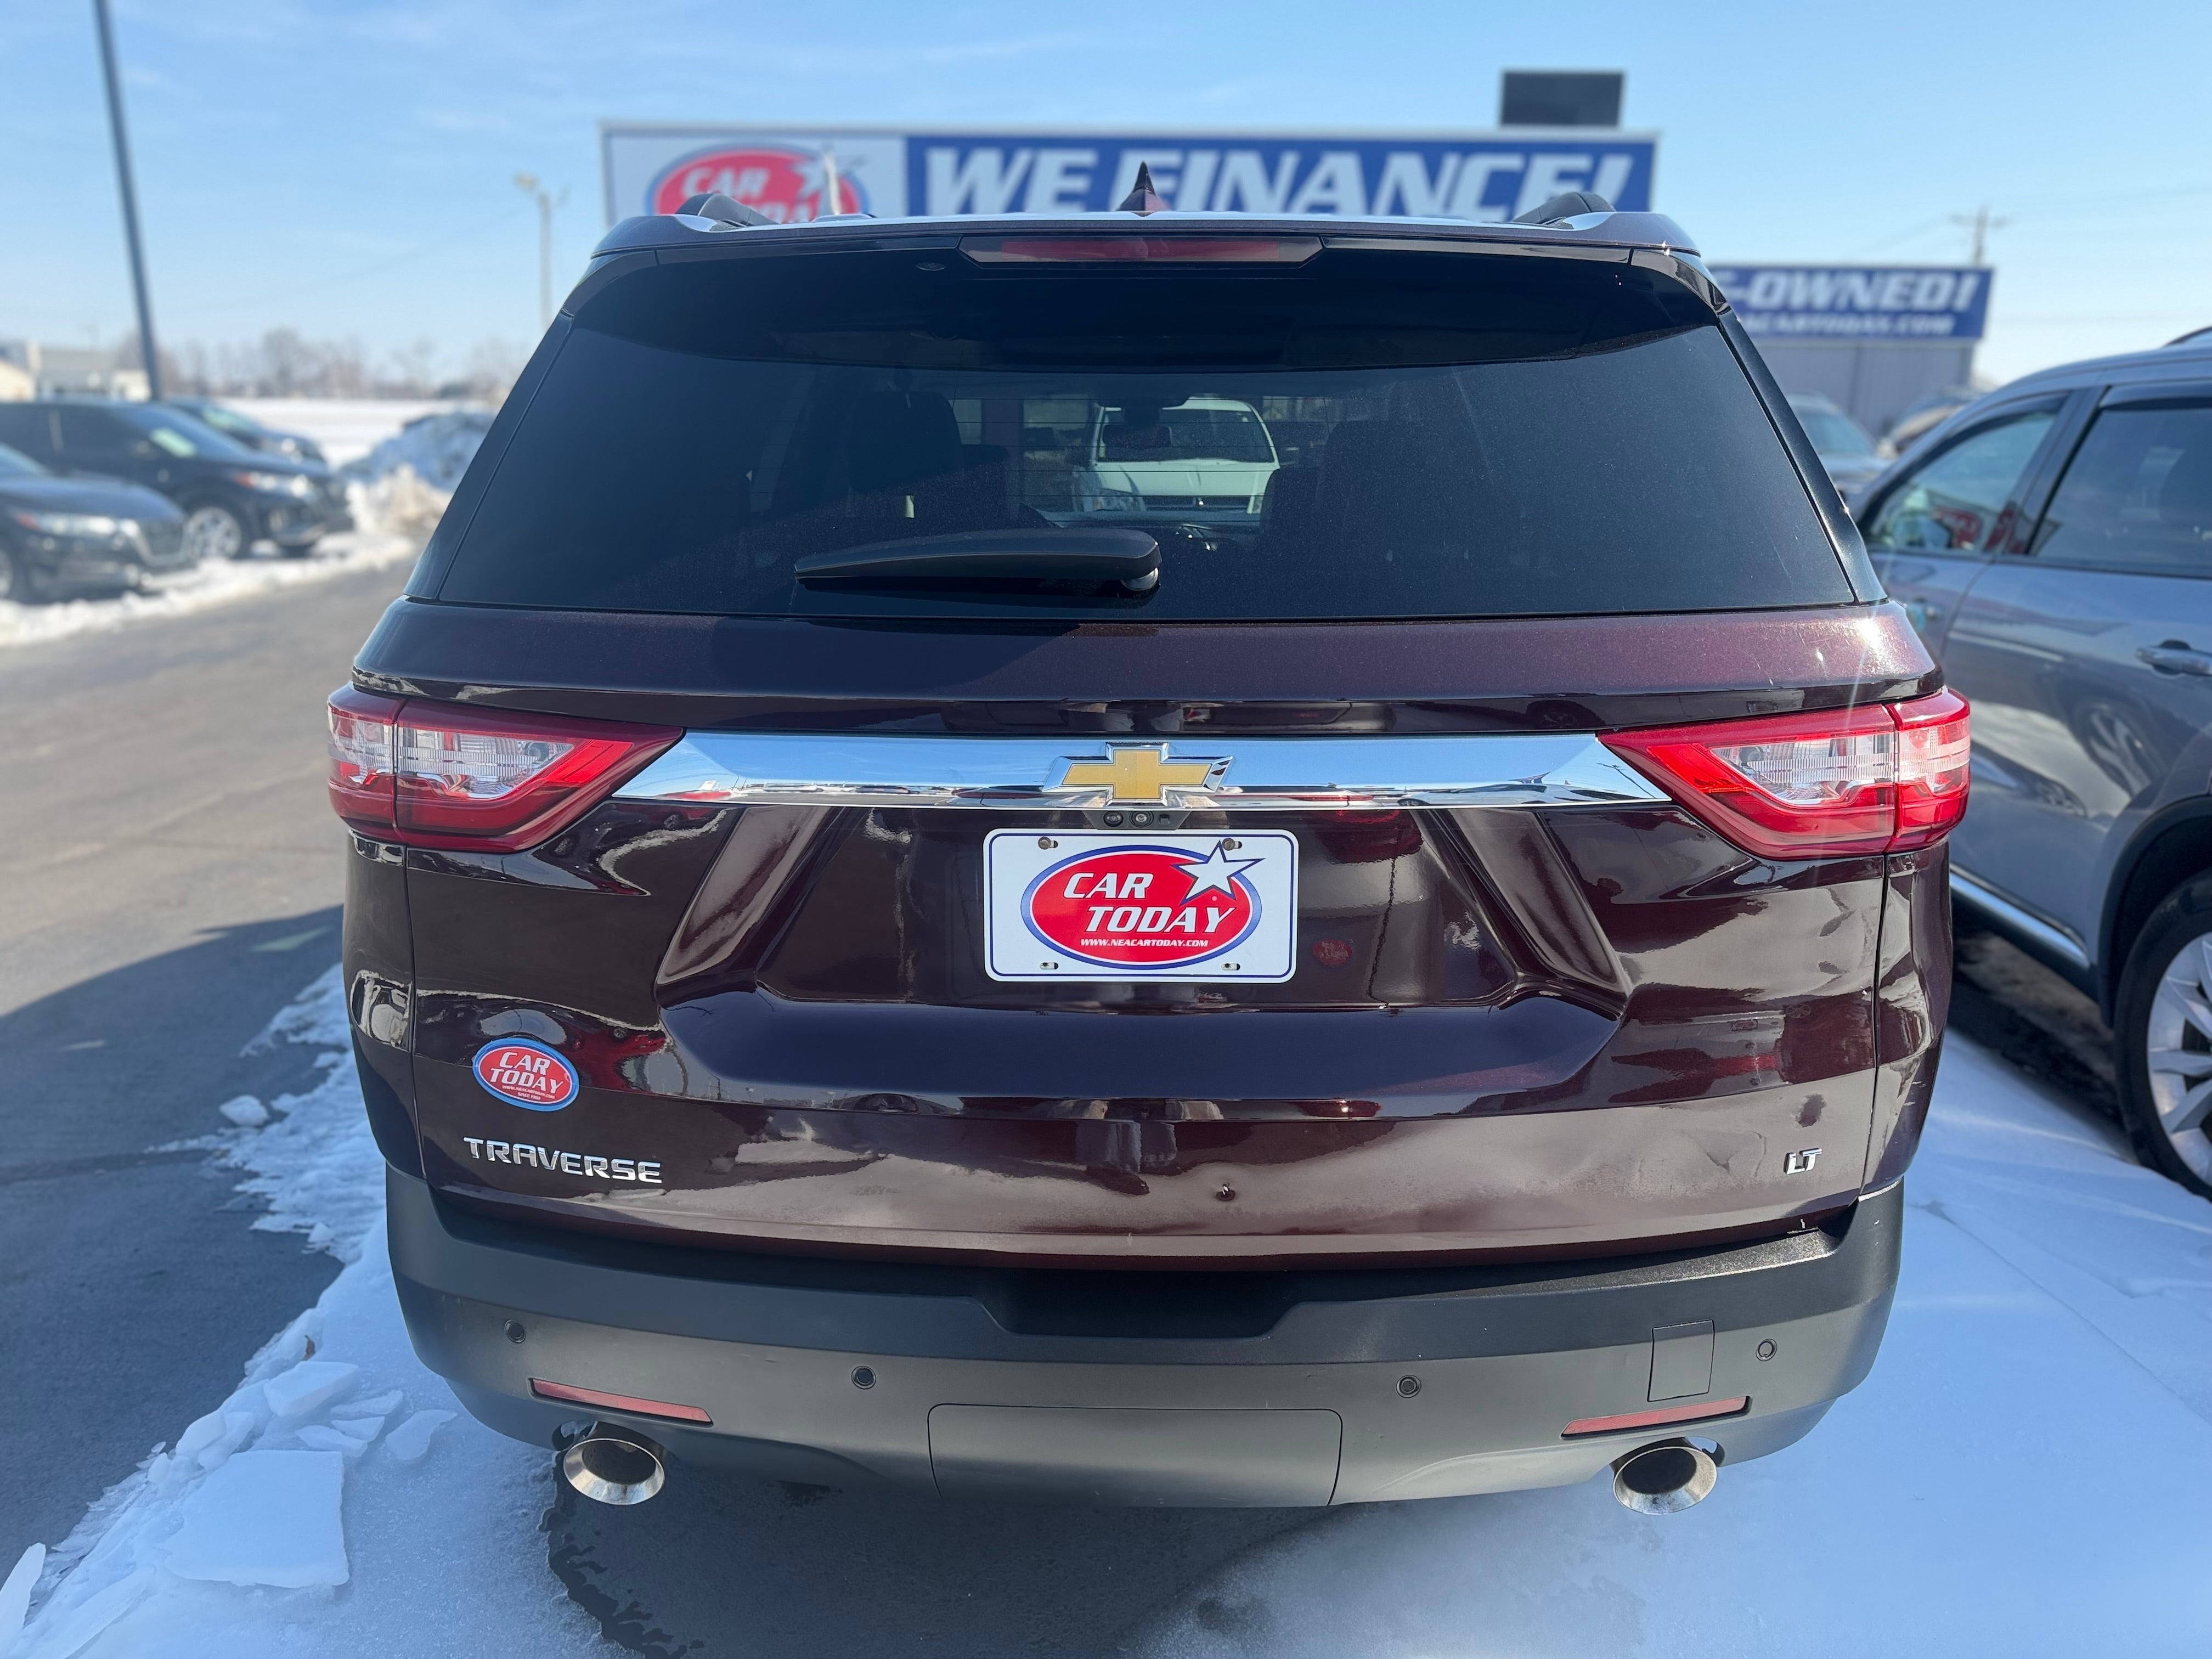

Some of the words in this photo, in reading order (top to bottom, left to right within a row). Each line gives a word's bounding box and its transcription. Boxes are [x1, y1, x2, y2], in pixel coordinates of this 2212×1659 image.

[681, 166, 770, 200] CAR
[926, 148, 1098, 216] WE
[1108, 150, 1633, 222] FINANCE!
[1063, 872, 1154, 899] CAR
[1085, 906, 1235, 933] TODAY
[1080, 938, 1209, 947] WWW.NEACARTODAY.COM
[499, 1052, 551, 1076] CAR
[490, 1068, 565, 1094] TODAY
[463, 1137, 662, 1184] TRAVERSE
[1784, 1147, 1822, 1175] LT
